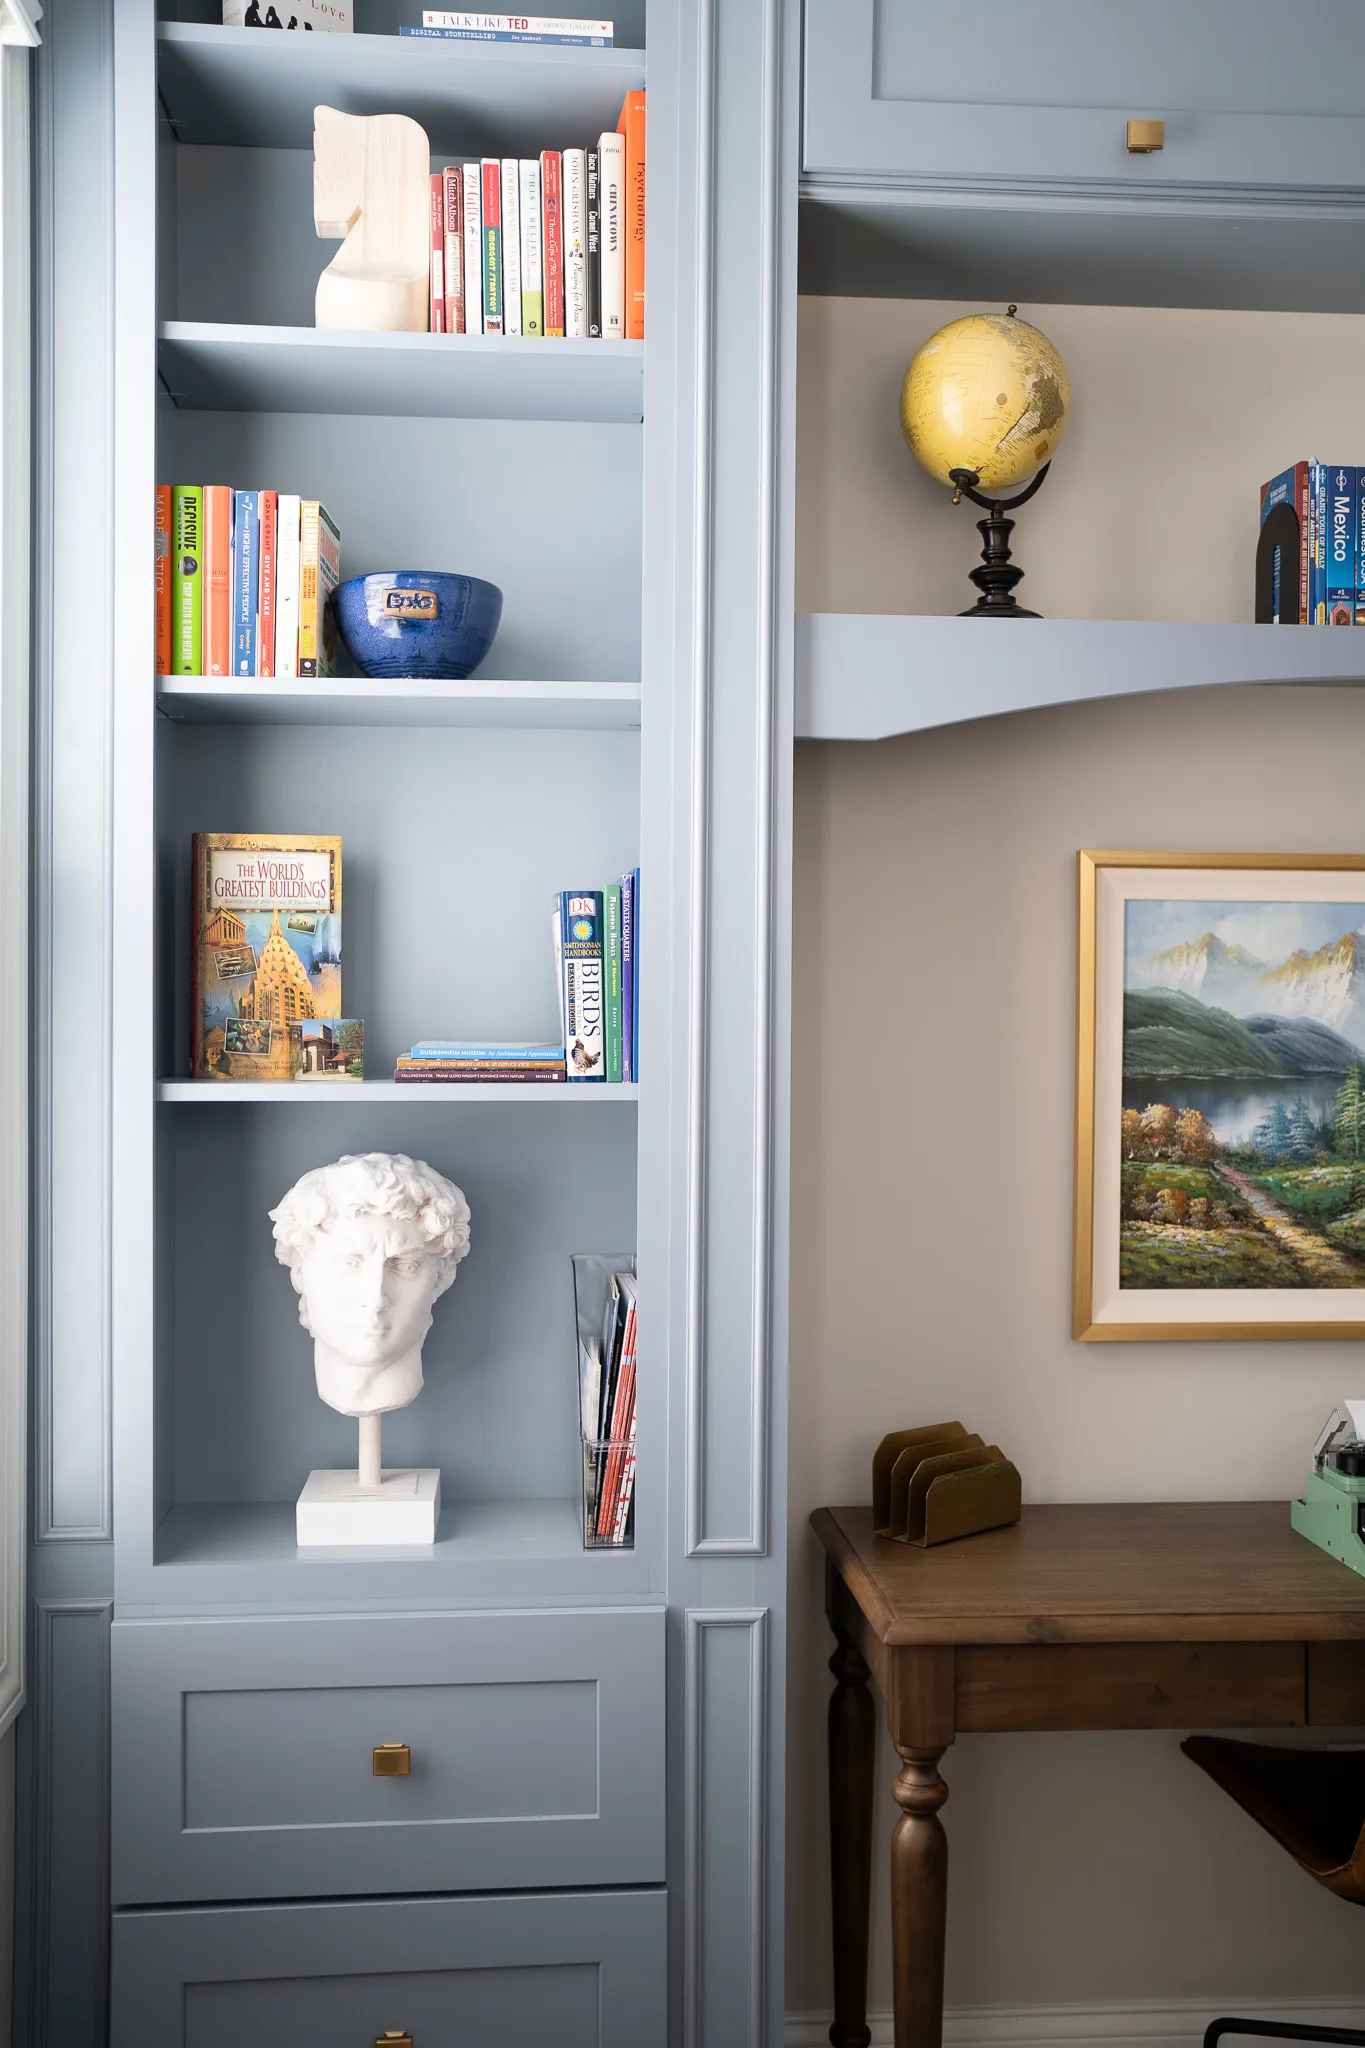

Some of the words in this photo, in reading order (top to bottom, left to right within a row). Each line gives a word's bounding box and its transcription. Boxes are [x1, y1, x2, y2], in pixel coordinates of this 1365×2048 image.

[440, 16, 471, 26] TALK
[476, 17, 505, 28] LIKE
[508, 18, 529, 30] TED
[410, 28, 441, 36] DIGITAL
[444, 30, 496, 40] STORYTELLING
[571, 156, 579, 183] JOHN
[589, 153, 598, 170] Race
[466, 174, 478, 188] 29
[589, 172, 598, 200] Matters
[466, 192, 479, 223] Gifts
[571, 186, 579, 234] GRISHAM
[634, 162, 645, 244] Psychology
[448, 203, 457, 230] Albom
[589, 211, 598, 233] Cornel
[610, 184, 618, 253] CHINATOWN
[548, 218, 556, 238] Three
[530, 217, 538, 267] BELIEVE
[548, 239, 558, 256] Cups
[589, 234, 598, 253] West
[550, 263, 558, 276] Tea
[571, 263, 582, 290] Playing
[571, 292, 582, 302] for
[574, 304, 583, 323] Pizza
[242, 502, 252, 510] 7
[178, 496, 197, 551] DECISIVE
[1334, 496, 1350, 562] Mexico
[1320, 536, 1326, 545] OF
[182, 582, 192, 597] CHIP
[182, 598, 192, 618] HEATH
[242, 594, 250, 622] PEOPLE
[182, 626, 192, 639] DAN
[182, 640, 192, 659] HEATH
[236, 864, 255, 878] THE
[256, 860, 304, 881] WORLD'S
[214, 877, 266, 898] GREATEST
[269, 879, 327, 899] BUILDINGS
[624, 890, 630, 898] 50
[572, 900, 593, 913] DK
[576, 962, 580, 970] OF
[582, 962, 601, 1037] BIRDS
